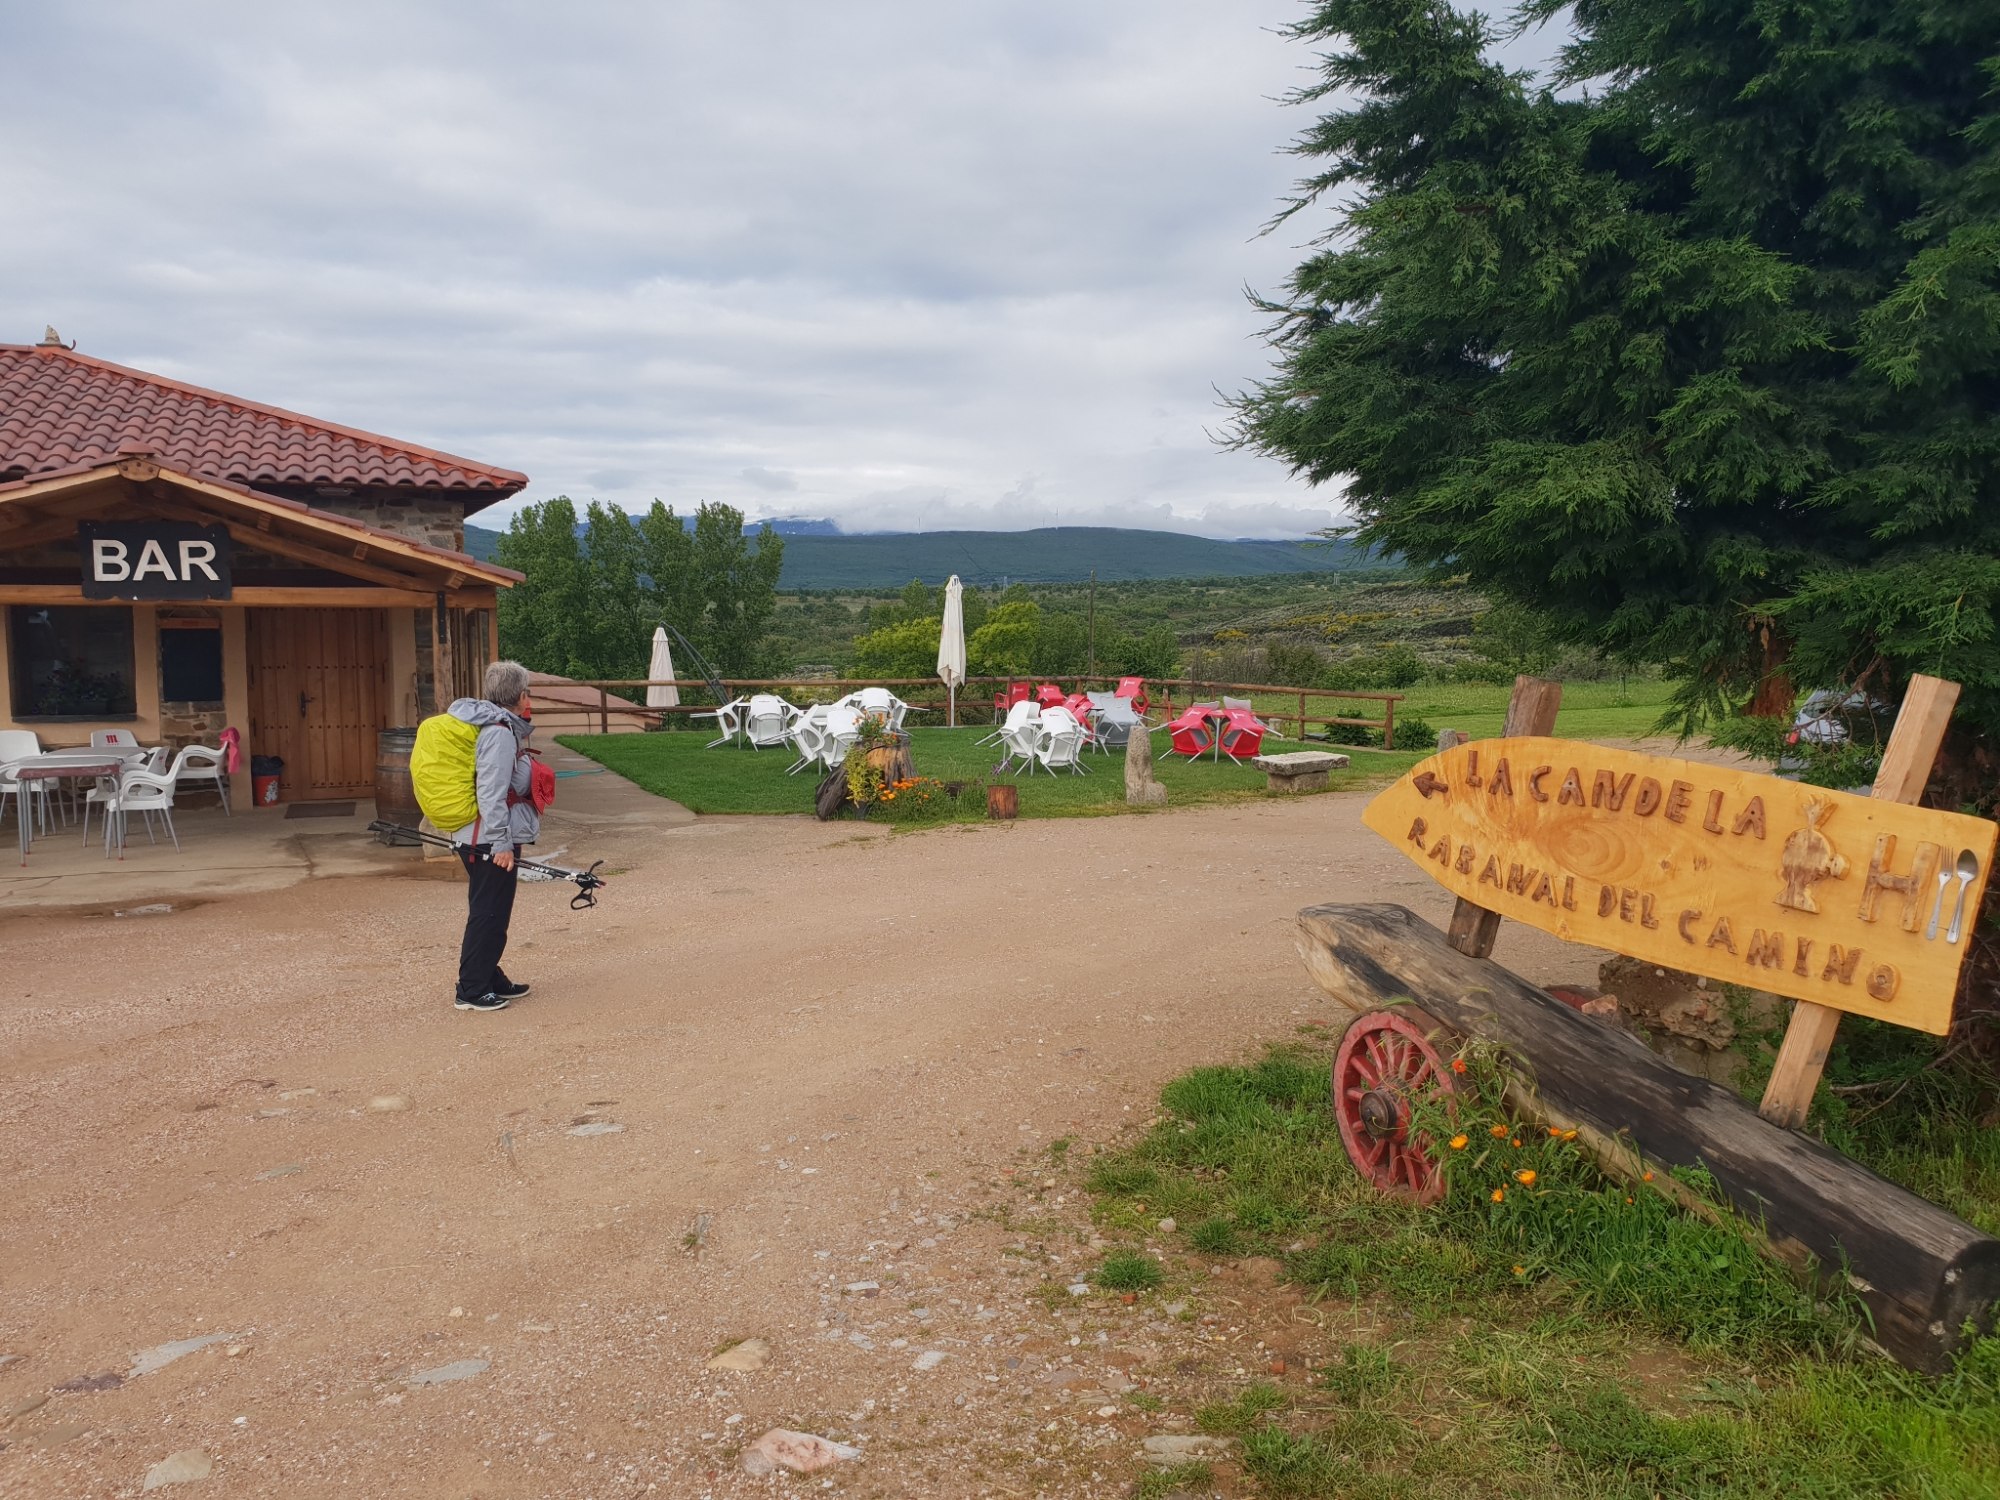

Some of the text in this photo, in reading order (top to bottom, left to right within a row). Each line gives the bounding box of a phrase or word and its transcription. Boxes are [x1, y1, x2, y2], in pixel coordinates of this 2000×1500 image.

[92, 539, 221, 582] BAR
[1464, 749, 1767, 840] LA CANDELA
[1406, 815, 1901, 1002] RABANAL DEL CAMINO
